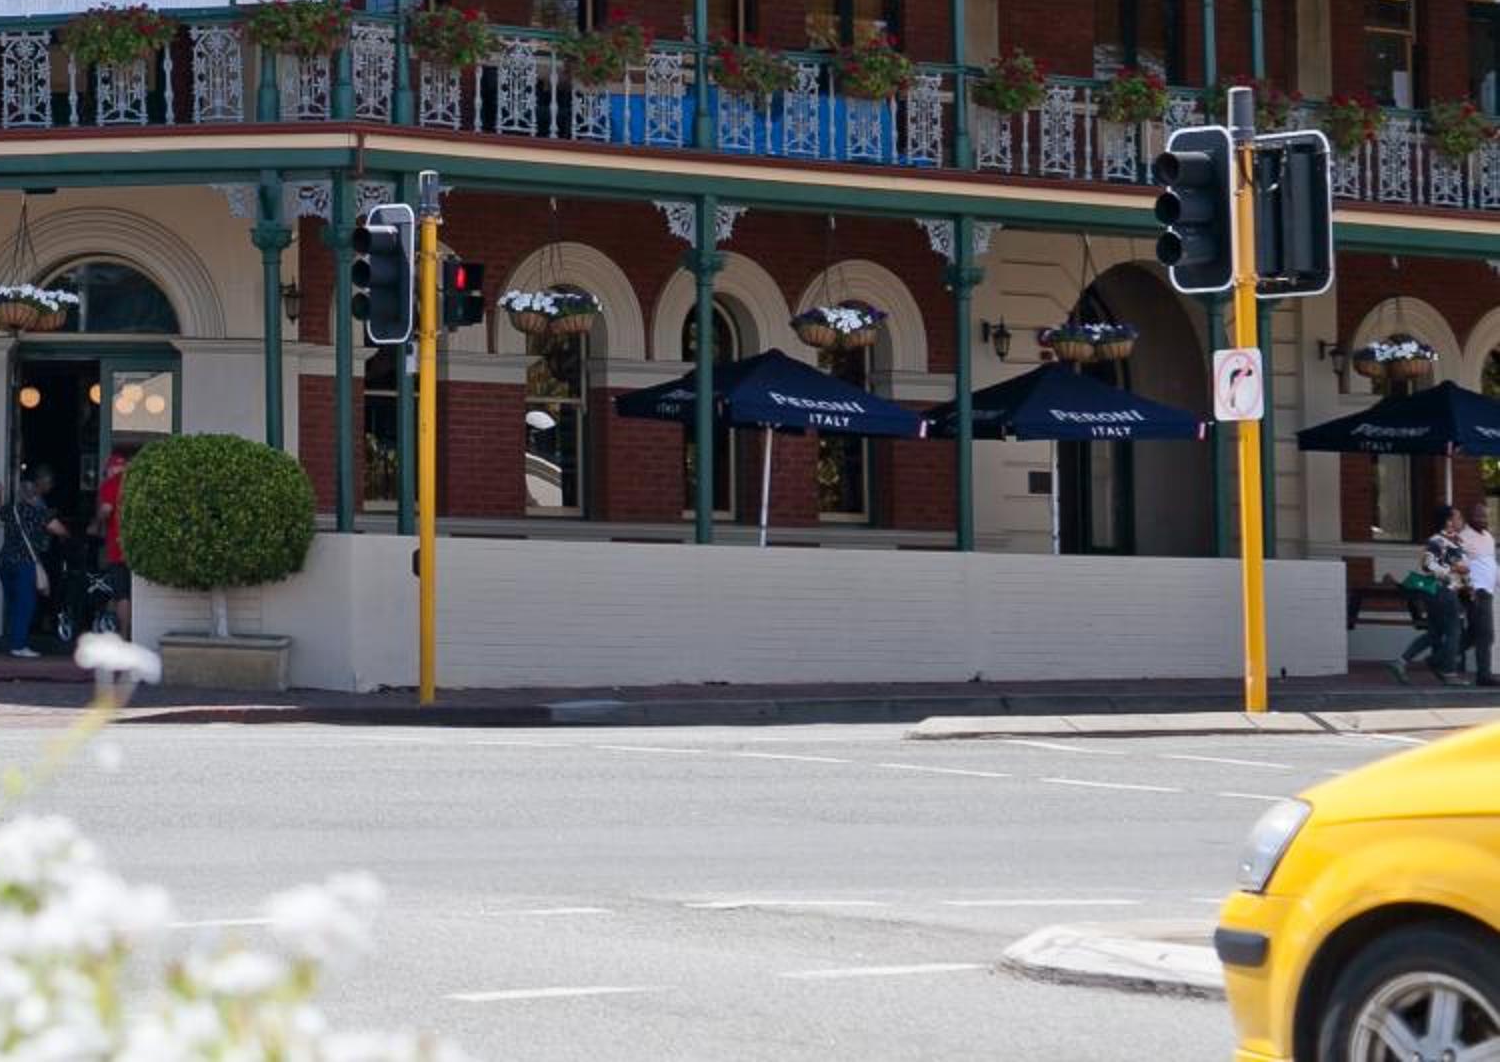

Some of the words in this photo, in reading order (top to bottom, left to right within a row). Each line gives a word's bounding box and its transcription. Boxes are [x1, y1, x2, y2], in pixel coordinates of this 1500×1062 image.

[768, 390, 866, 413] PERONI
[809, 413, 849, 427] ITALY
[1049, 409, 1146, 423] PERONI
[1092, 425, 1132, 437] ITALY
